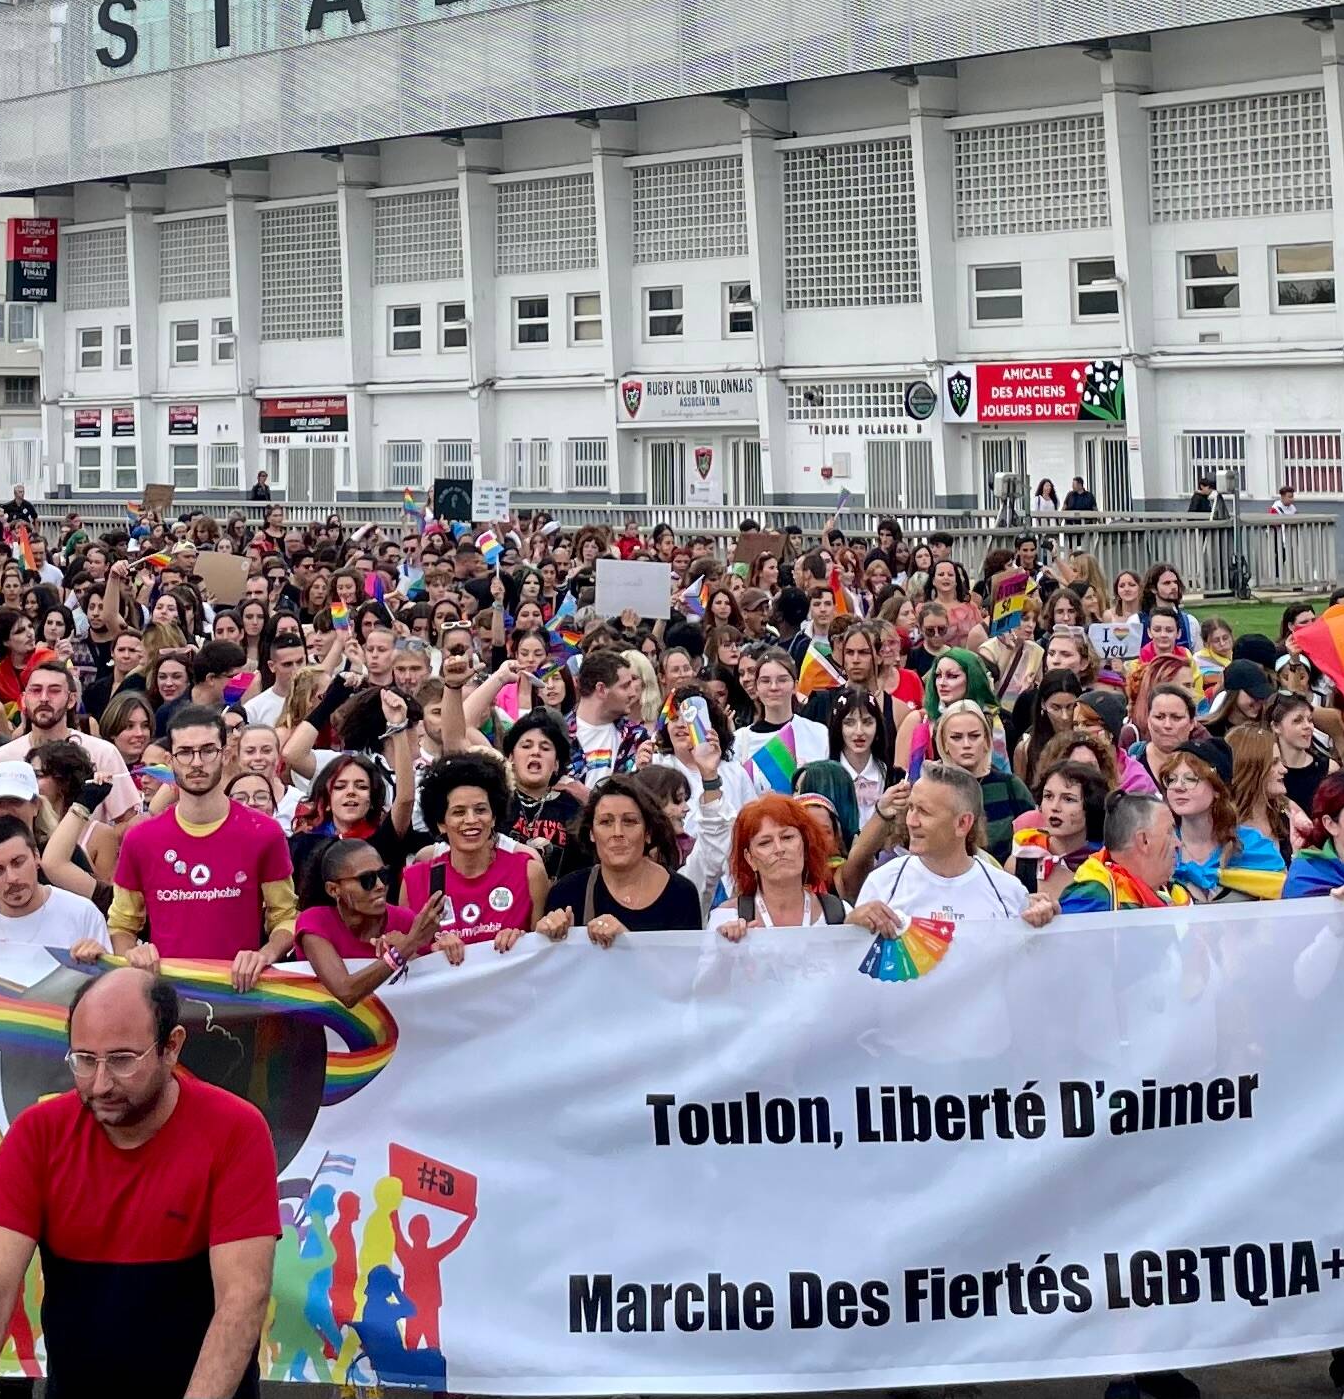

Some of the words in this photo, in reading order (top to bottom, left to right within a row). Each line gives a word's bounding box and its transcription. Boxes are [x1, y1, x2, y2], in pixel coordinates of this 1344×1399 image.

[1003, 367, 1053, 380] AMICALE
[647, 380, 674, 396] RUGBY
[676, 379, 698, 395] CLUB
[700, 377, 754, 394] TOULONNAIS
[991, 386, 1013, 398] DES
[1016, 385, 1066, 398] ANCIENS
[679, 396, 721, 407] ASSOCIATION
[982, 404, 1033, 417] JOUEURS
[1035, 403, 1052, 416] DU
[1054, 402, 1078, 416] RCT
[808, 424, 850, 435] TRIBUNE
[1102, 627, 1109, 643] I
[1101, 645, 1129, 660] YOU
[646, 1090, 844, 1150] Toulon,
[854, 1080, 1047, 1144] Liberté
[417, 1162, 455, 1197] #3
[568, 1273, 775, 1333] Marche
[789, 1271, 892, 1331] Des
[903, 1253, 1093, 1324] Fiertés
